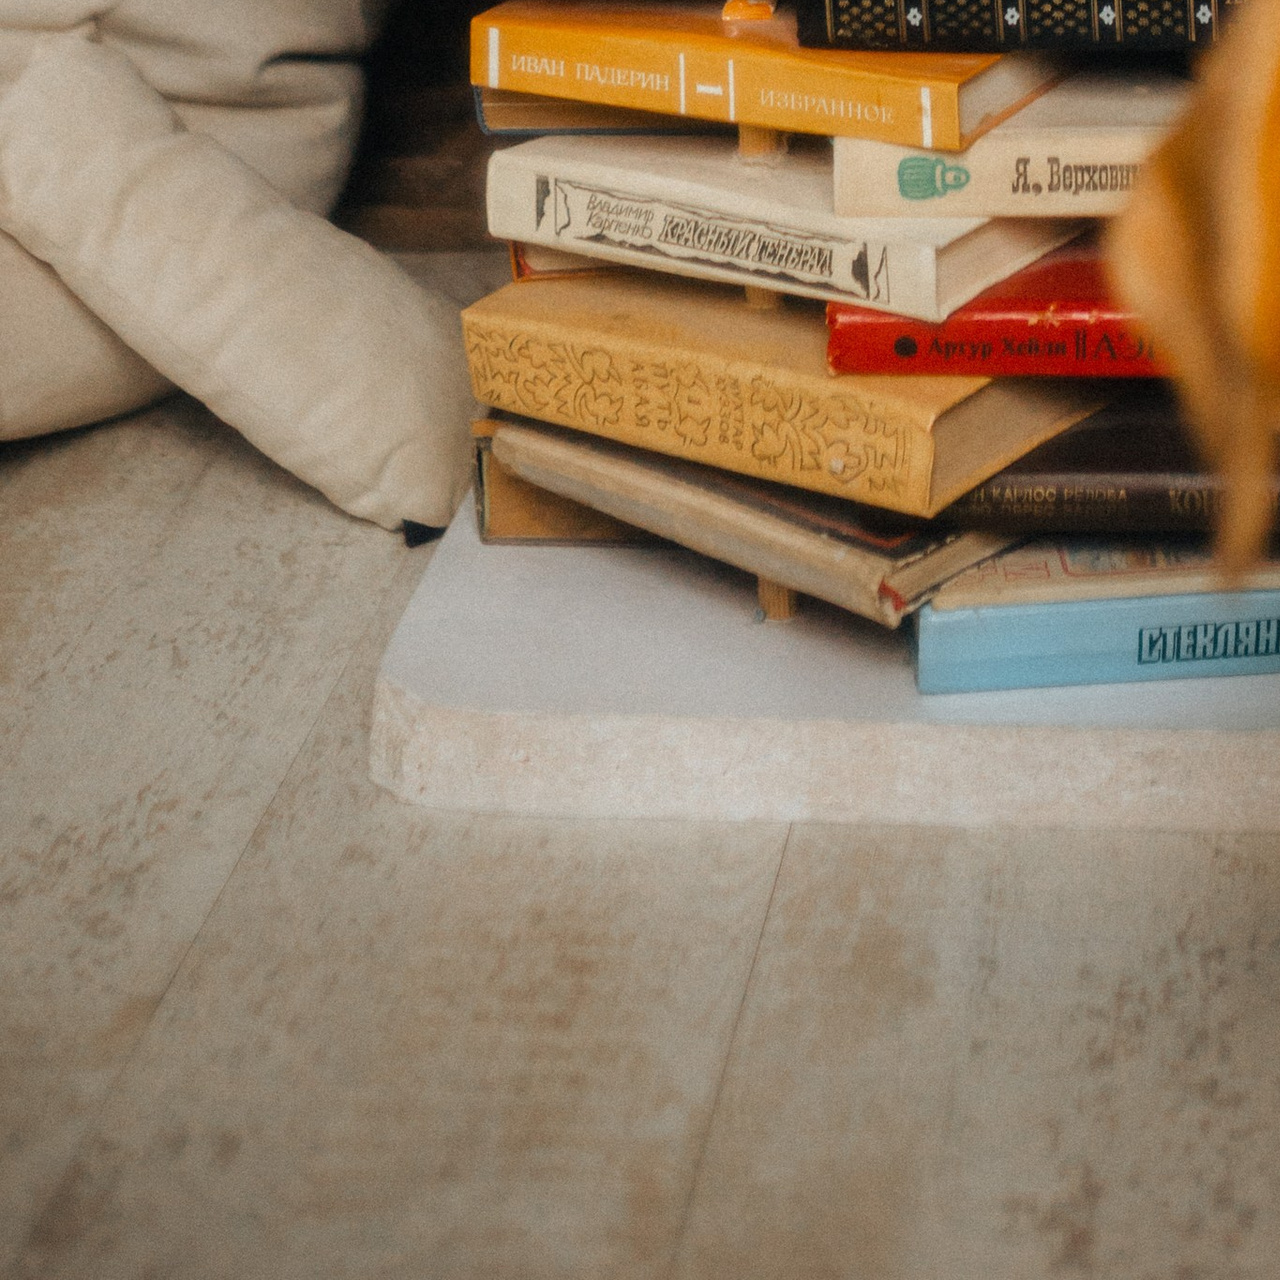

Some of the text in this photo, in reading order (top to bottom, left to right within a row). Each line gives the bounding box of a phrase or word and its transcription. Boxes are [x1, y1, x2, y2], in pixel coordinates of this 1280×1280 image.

[511, 54, 670, 92] ИВАН ПАДЕРИН
[760, 88, 894, 124] ИЗБРАННОЕ
[658, 214, 833, 277] КРАСНЫЙ ГЕНЕРАЛ
[928, 337, 993, 361] Артур
[1002, 337, 1067, 357] Хейли
[651, 362, 672, 431] ПУТЬ
